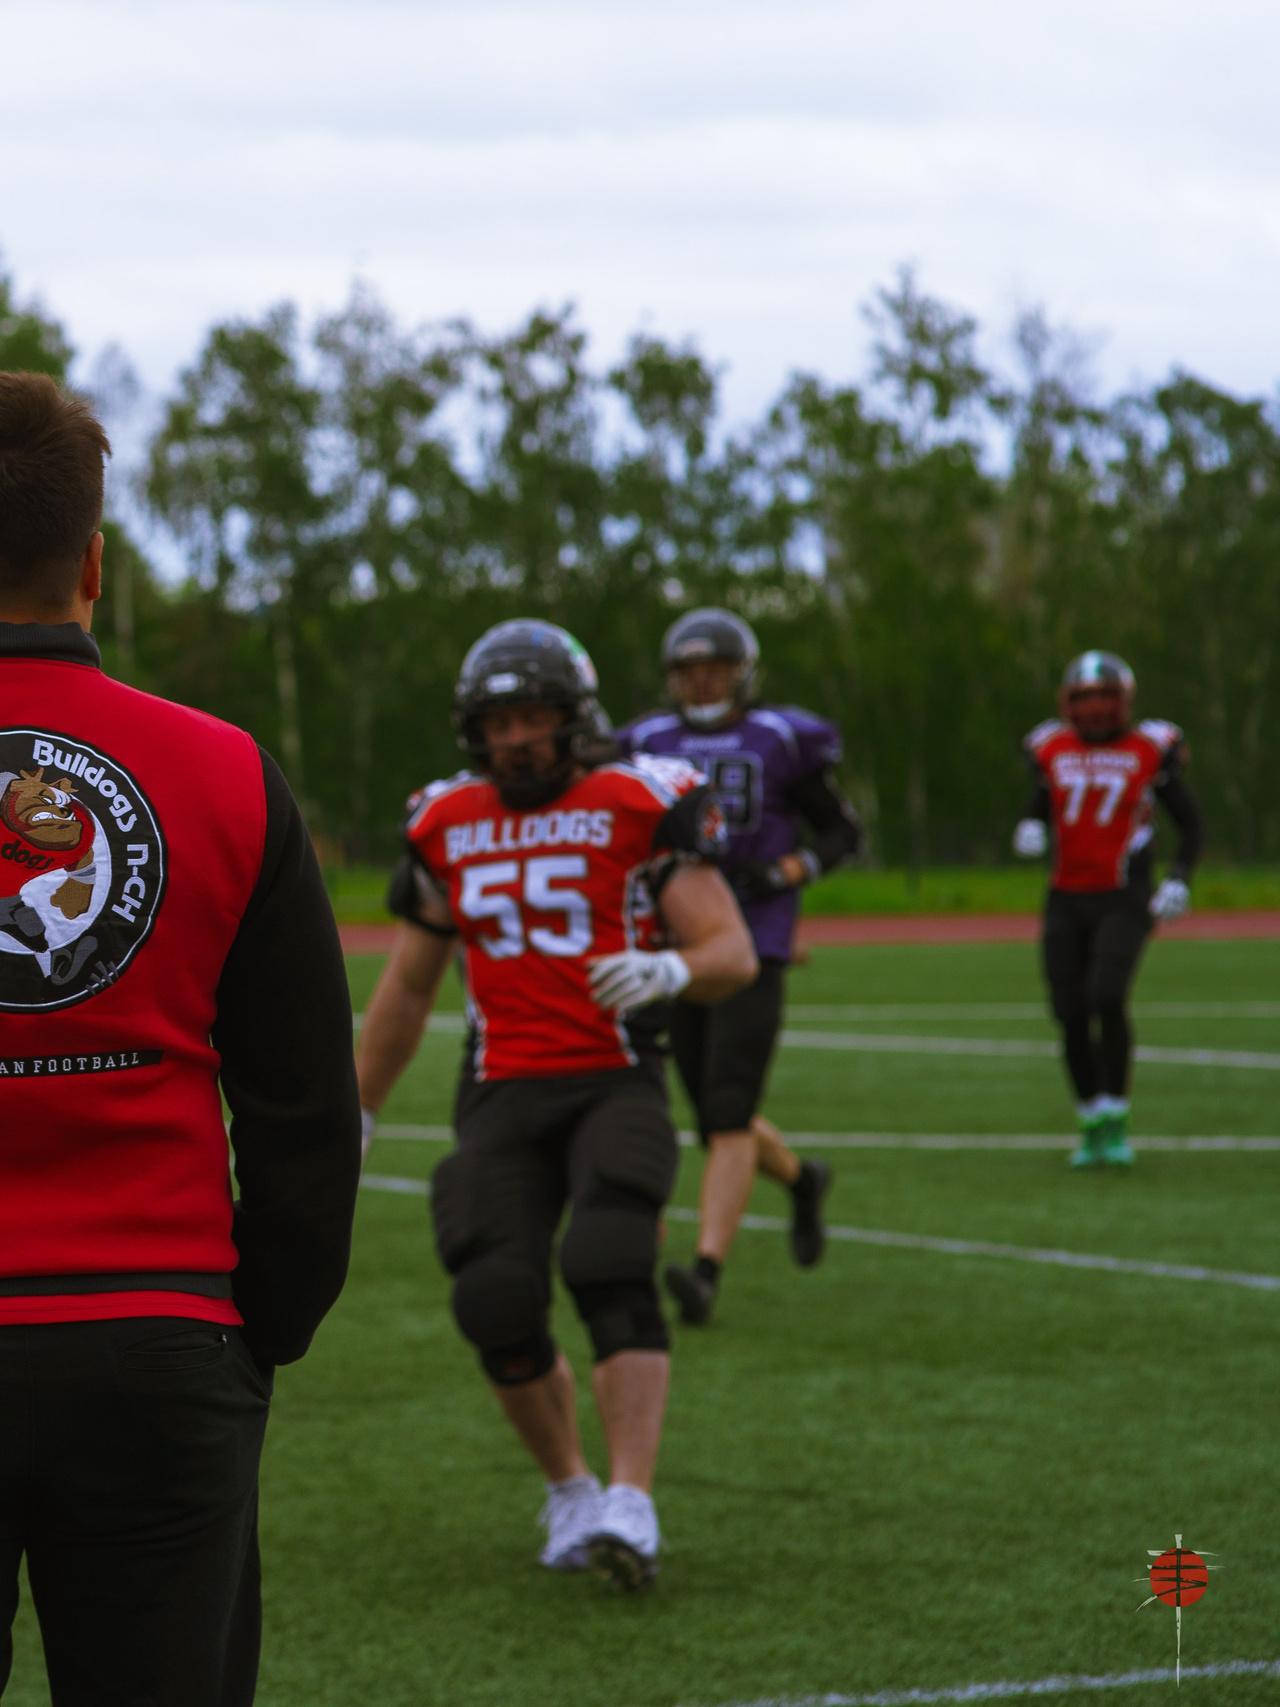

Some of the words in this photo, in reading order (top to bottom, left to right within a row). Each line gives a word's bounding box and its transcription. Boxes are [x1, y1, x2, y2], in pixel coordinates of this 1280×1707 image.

[32, 739, 138, 833] Bulldogs
[1052, 768, 1128, 827] 77
[1, 840, 55, 872] dogs
[444, 809, 614, 865] BULLDOGS
[460, 853, 594, 961] 55
[33, 1052, 140, 1075] FOOTBALL
